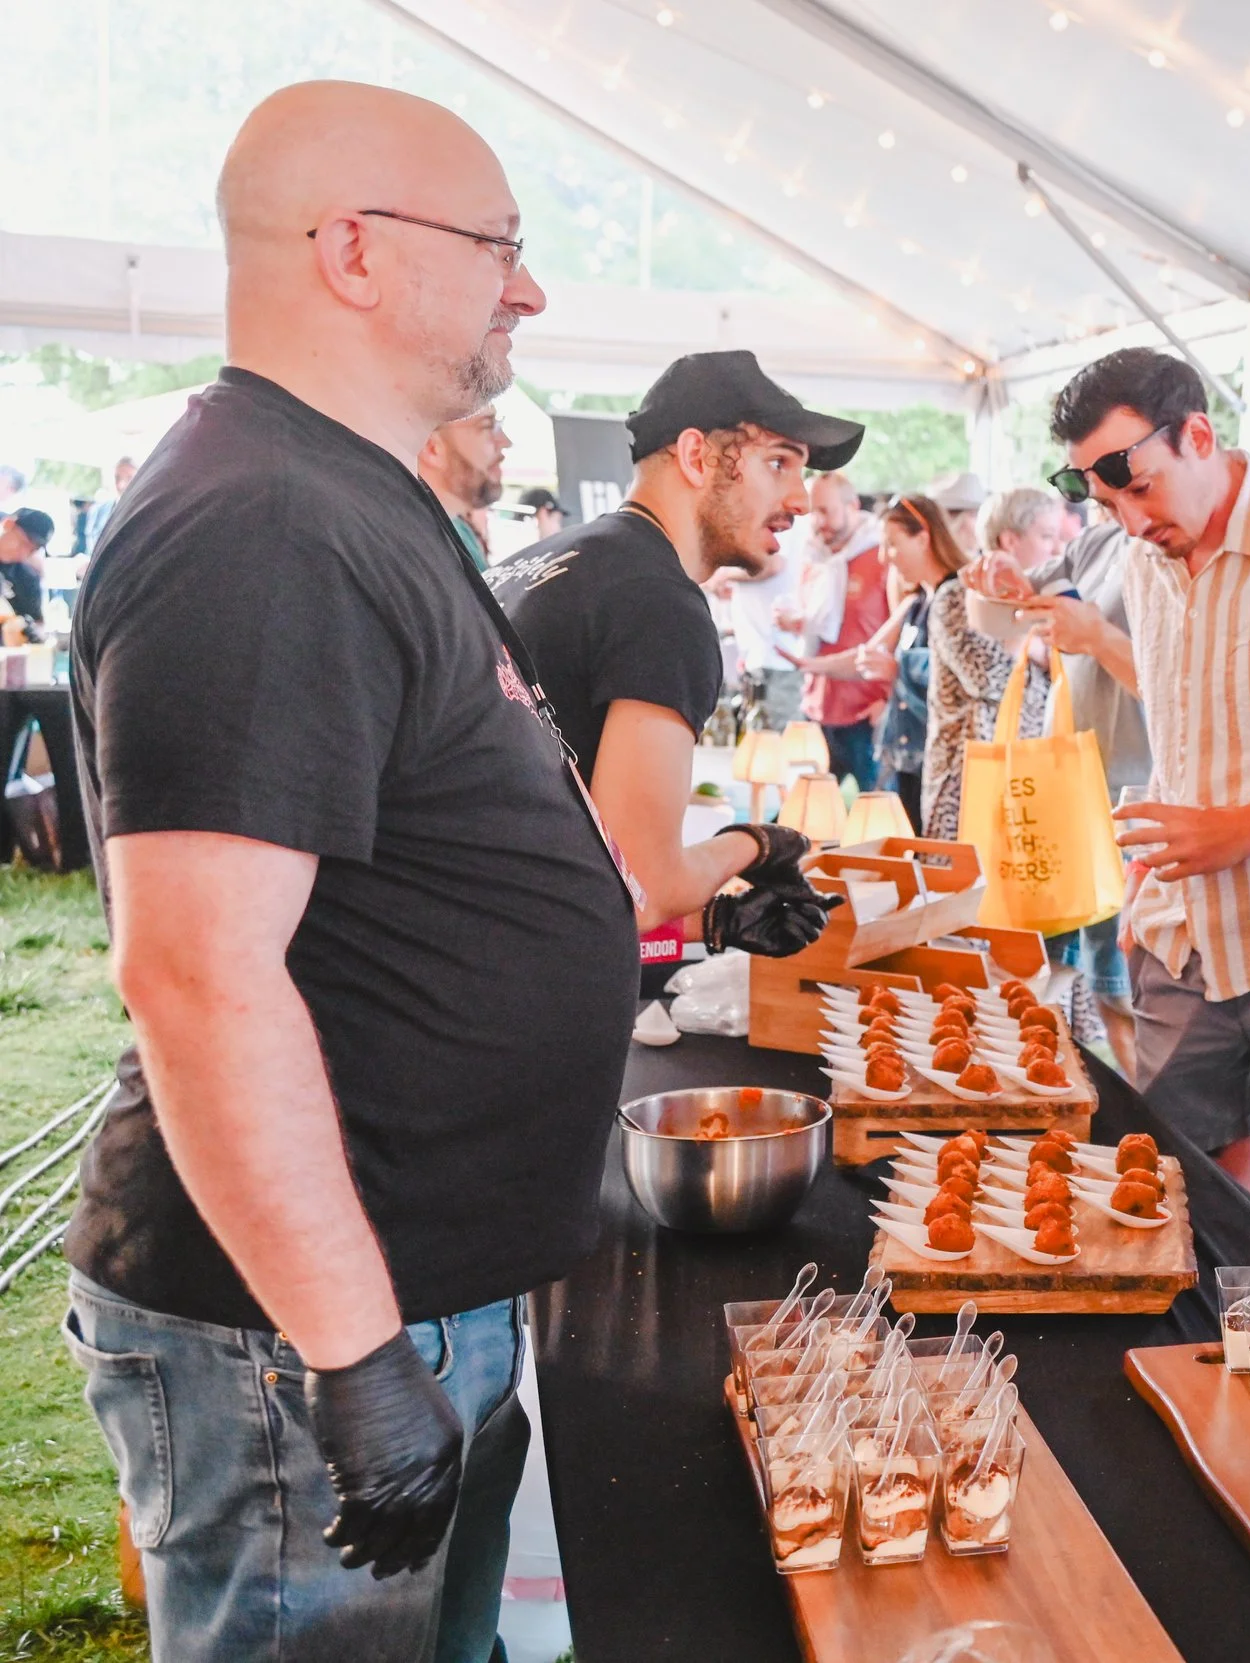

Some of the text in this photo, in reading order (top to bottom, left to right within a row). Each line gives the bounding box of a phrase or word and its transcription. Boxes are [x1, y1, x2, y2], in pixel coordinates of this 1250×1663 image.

[1010, 777, 1036, 797] ES
[1005, 806, 1037, 826] ELL
[640, 939, 677, 959] ENDOR
